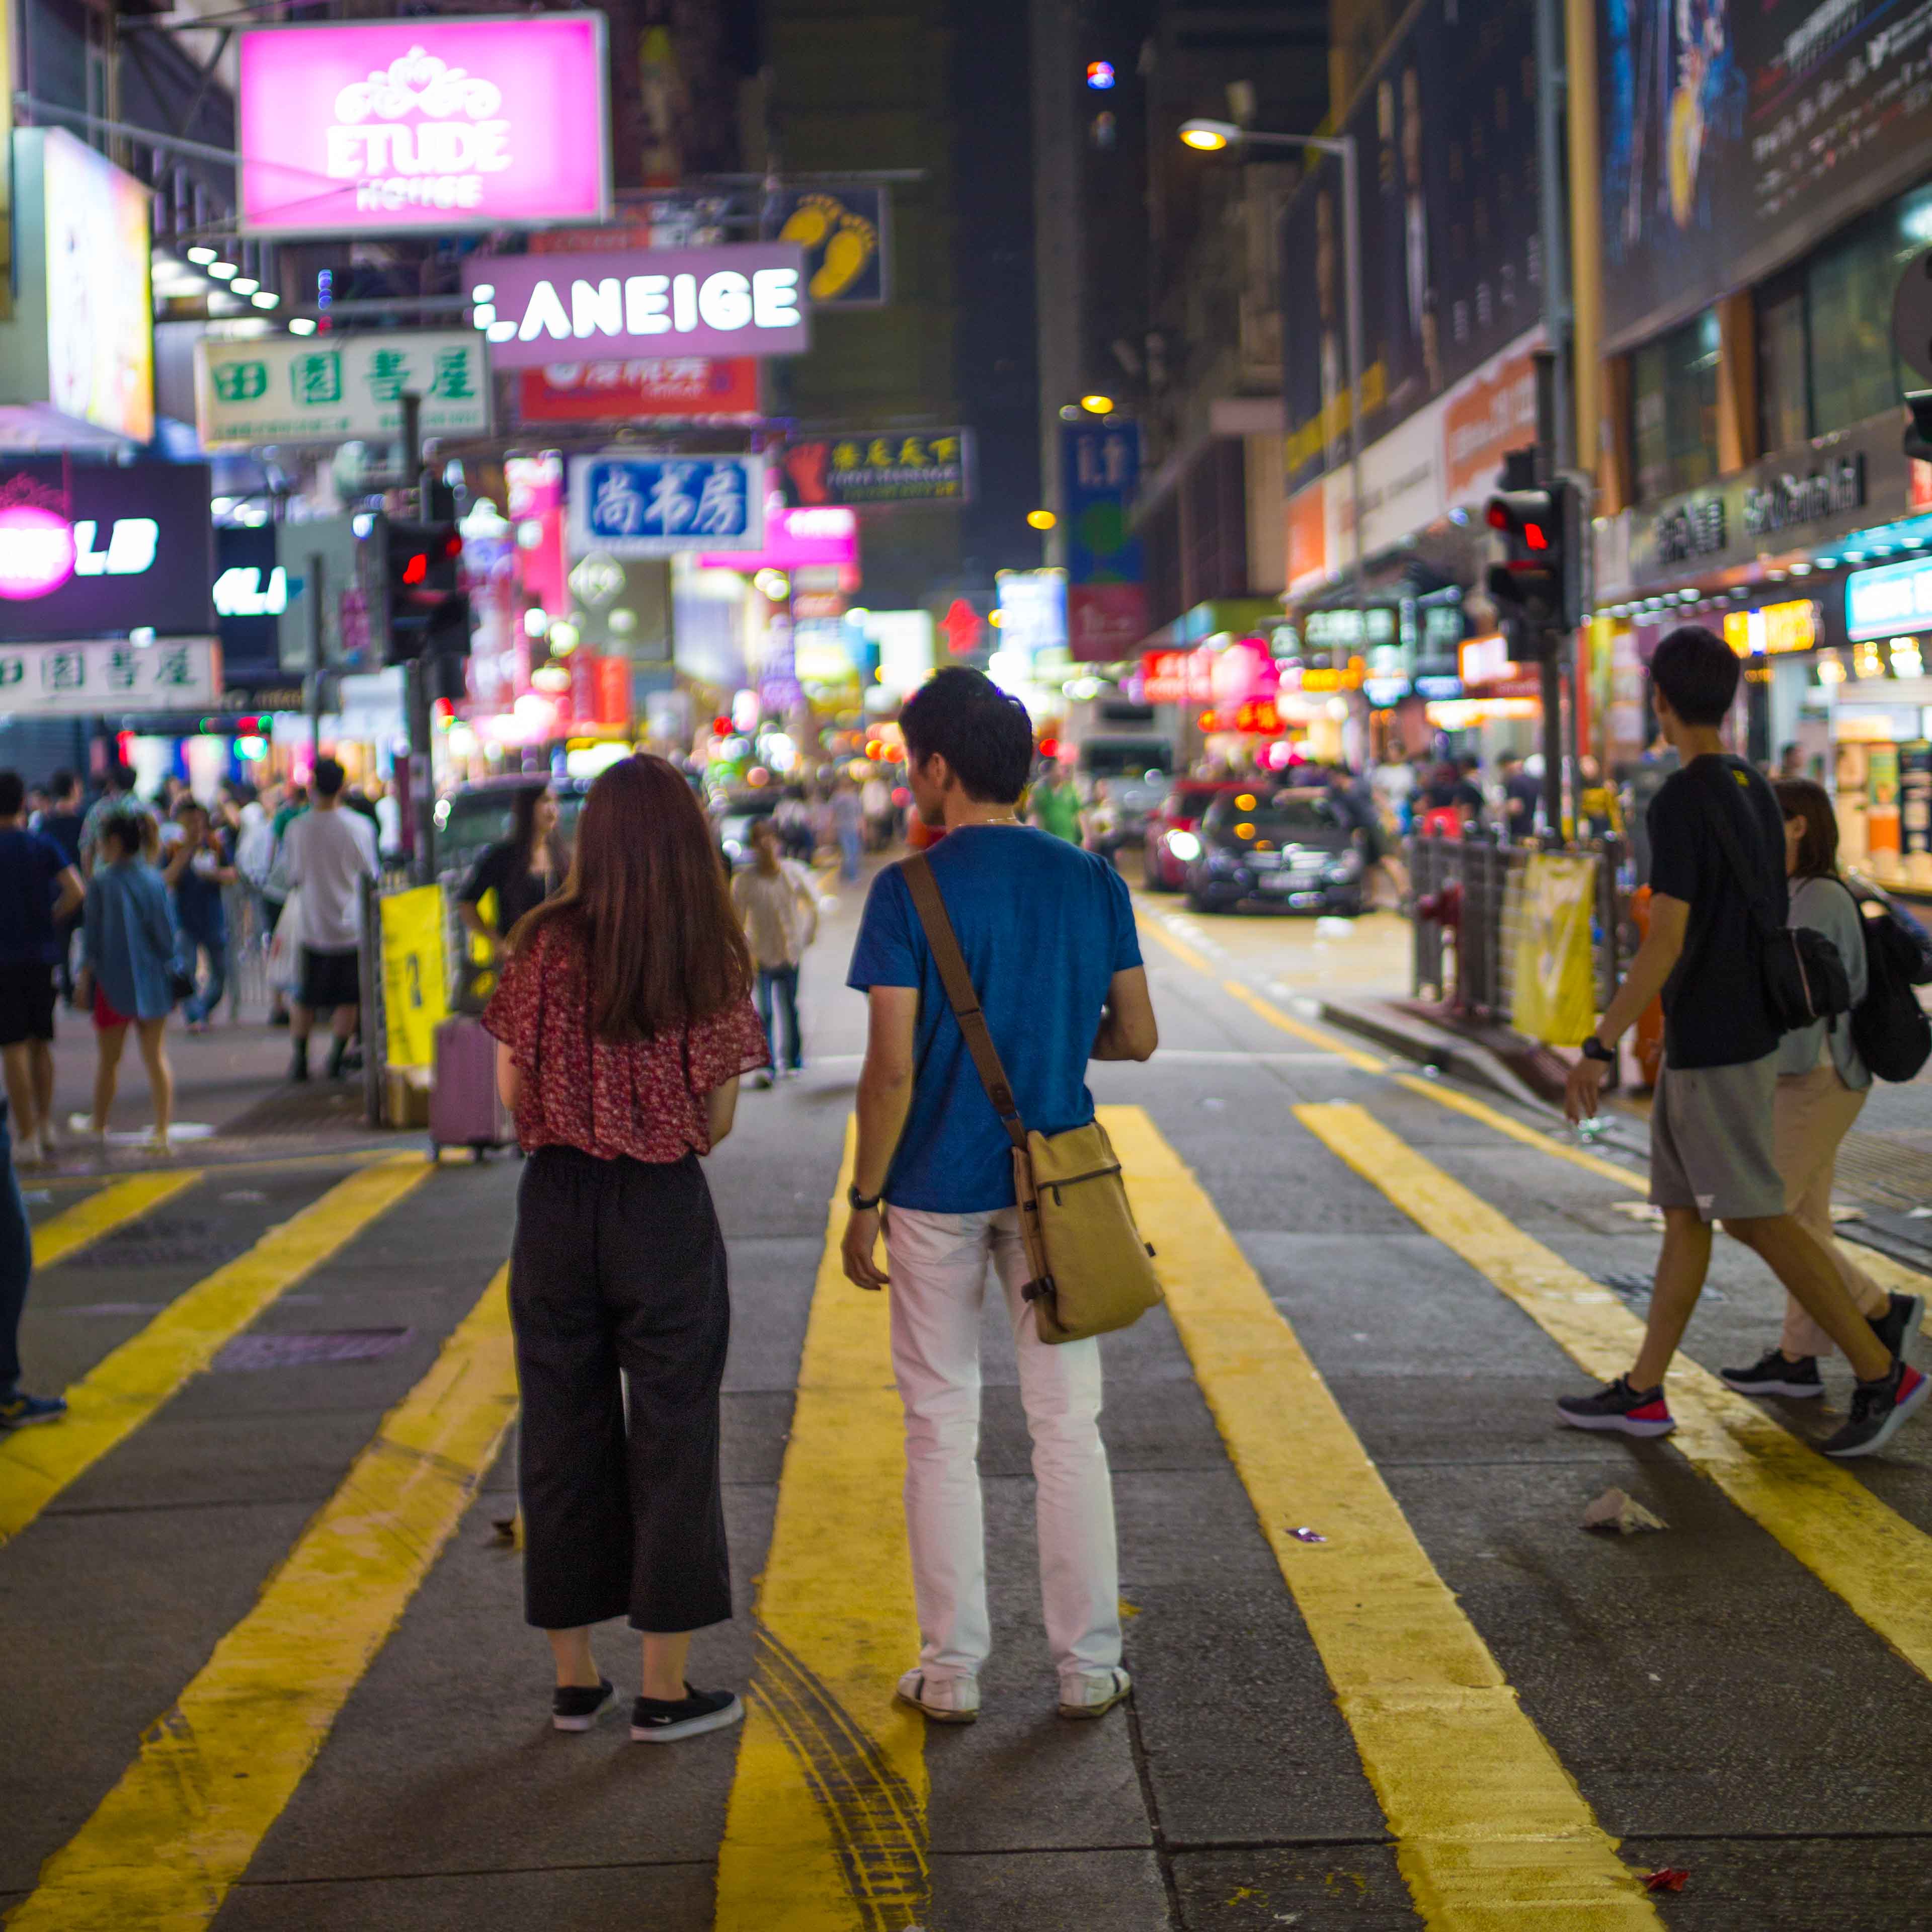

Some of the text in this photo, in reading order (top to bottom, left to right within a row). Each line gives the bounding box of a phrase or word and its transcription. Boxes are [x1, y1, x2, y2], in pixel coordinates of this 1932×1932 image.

[327, 120, 513, 178] ETUDE
[472, 268, 801, 343] LANEIGE
[74, 518, 159, 576] LB
